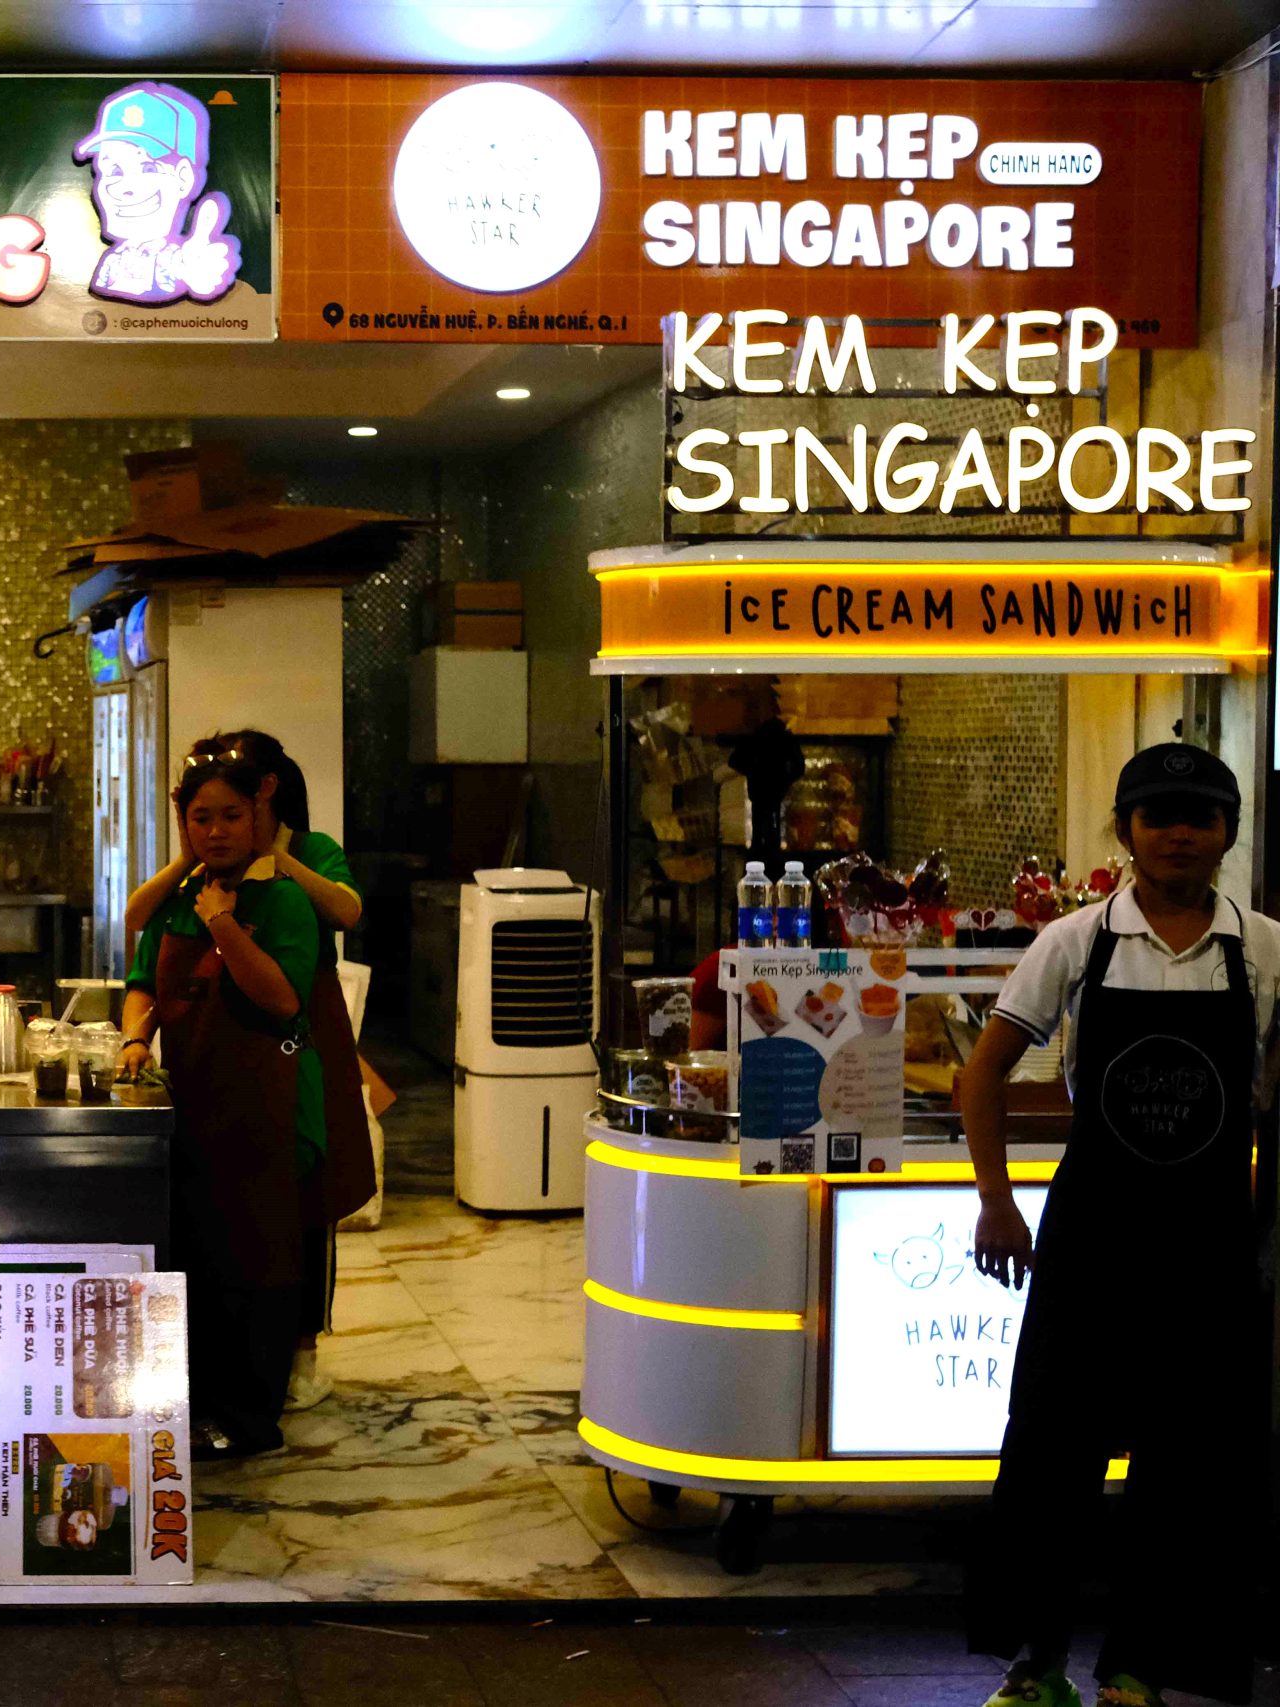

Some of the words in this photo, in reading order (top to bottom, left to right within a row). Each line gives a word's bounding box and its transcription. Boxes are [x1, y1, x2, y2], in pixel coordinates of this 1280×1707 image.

[642, 110, 807, 181] KEM
[835, 112, 980, 196] KẸP
[447, 192, 541, 218] HAWKER
[470, 220, 520, 246] STAR
[642, 200, 1076, 271] SINGAPORE
[120, 316, 249, 331] @caphemuoichulong
[349, 313, 369, 329] 68
[374, 305, 440, 330] NGUYỄN
[487, 314, 502, 330] P.
[507, 305, 540, 330] BẾN
[671, 310, 877, 395] KEM
[943, 308, 1119, 418] KẸP
[668, 423, 1257, 515] SINGAPORE
[812, 583, 954, 638] CREAM
[753, 964, 779, 977] Kem
[906, 1314, 1012, 1345] HAWKE
[936, 1354, 1001, 1389] STAR
[24, 1385, 32, 1416] 20.000
[55, 1385, 63, 1416] 20.000
[152, 1430, 183, 1482] GIÁ
[151, 1490, 187, 1563] 20K
